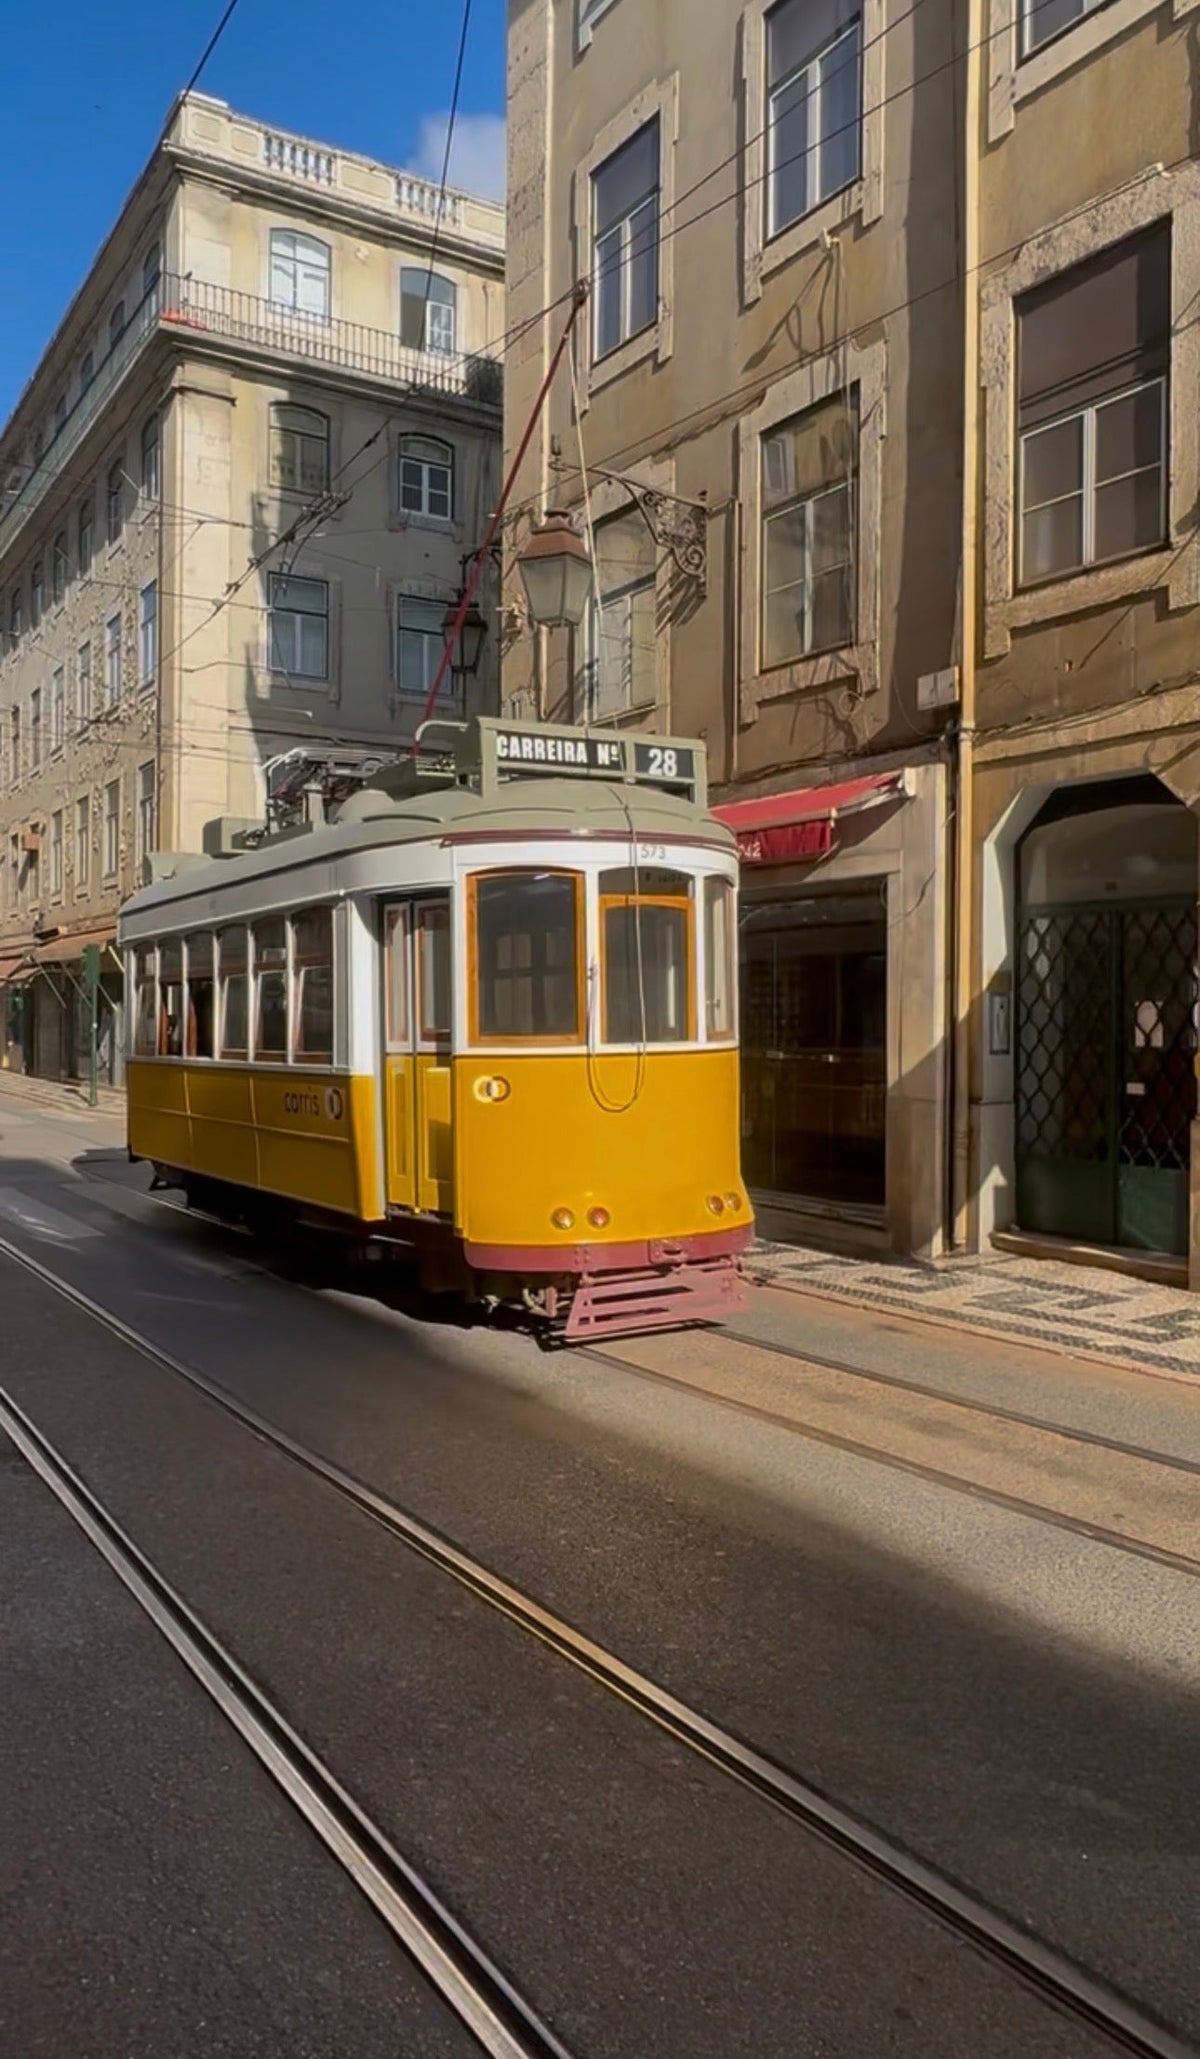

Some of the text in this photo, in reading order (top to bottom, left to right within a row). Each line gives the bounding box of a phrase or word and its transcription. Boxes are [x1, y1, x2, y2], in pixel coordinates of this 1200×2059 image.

[496, 735, 588, 763] CARREIRA
[648, 748, 678, 777] 28
[641, 844, 666, 859] 573
[284, 1086, 320, 1116] carris
